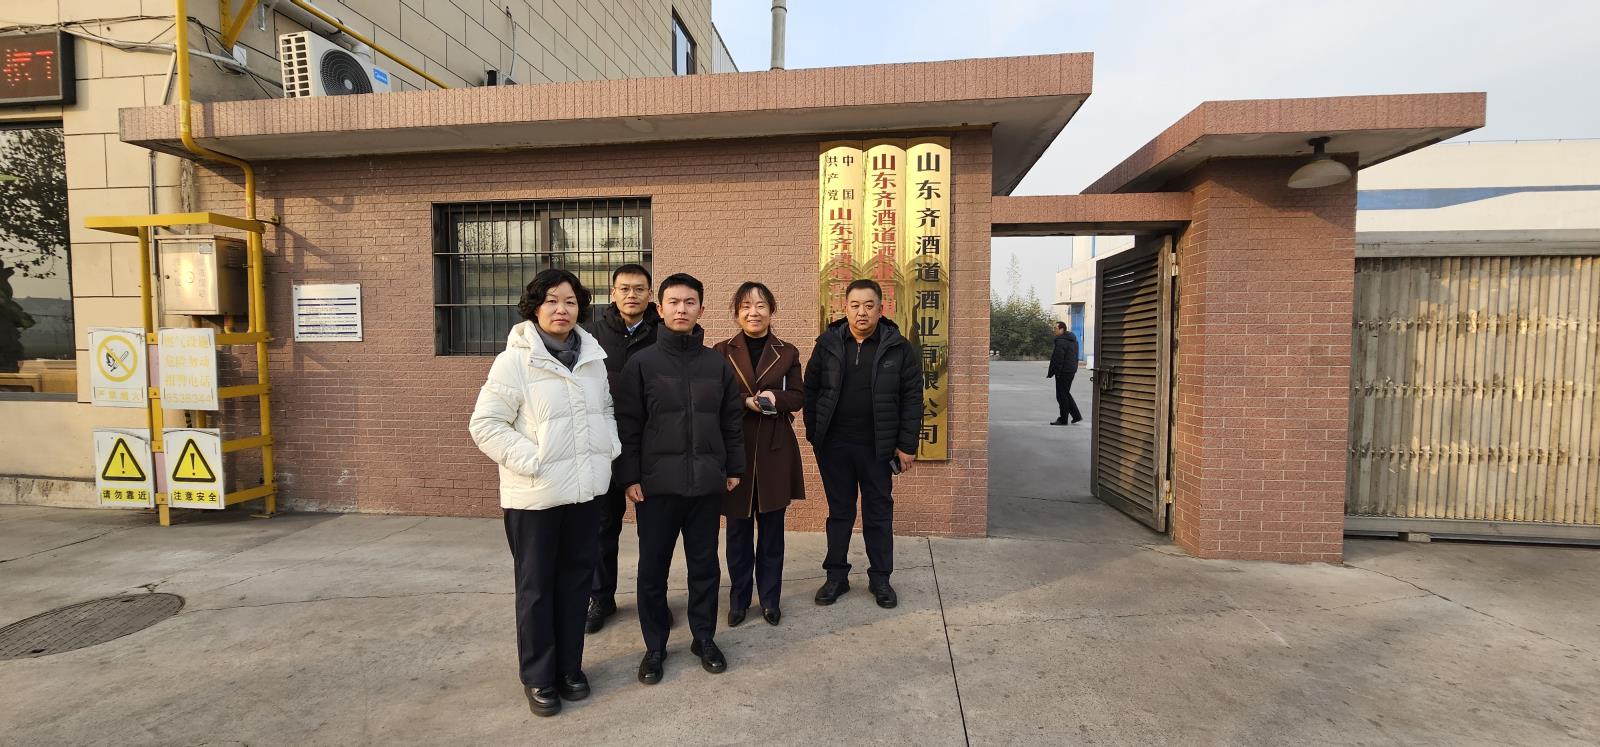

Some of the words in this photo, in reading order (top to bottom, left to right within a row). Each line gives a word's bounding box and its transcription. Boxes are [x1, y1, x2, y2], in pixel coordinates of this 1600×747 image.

[827, 155, 839, 201] 共产党
[843, 155, 854, 200] 中国
[102, 490, 147, 501] 请勿靠近
[173, 491, 217, 502] 注意安全
